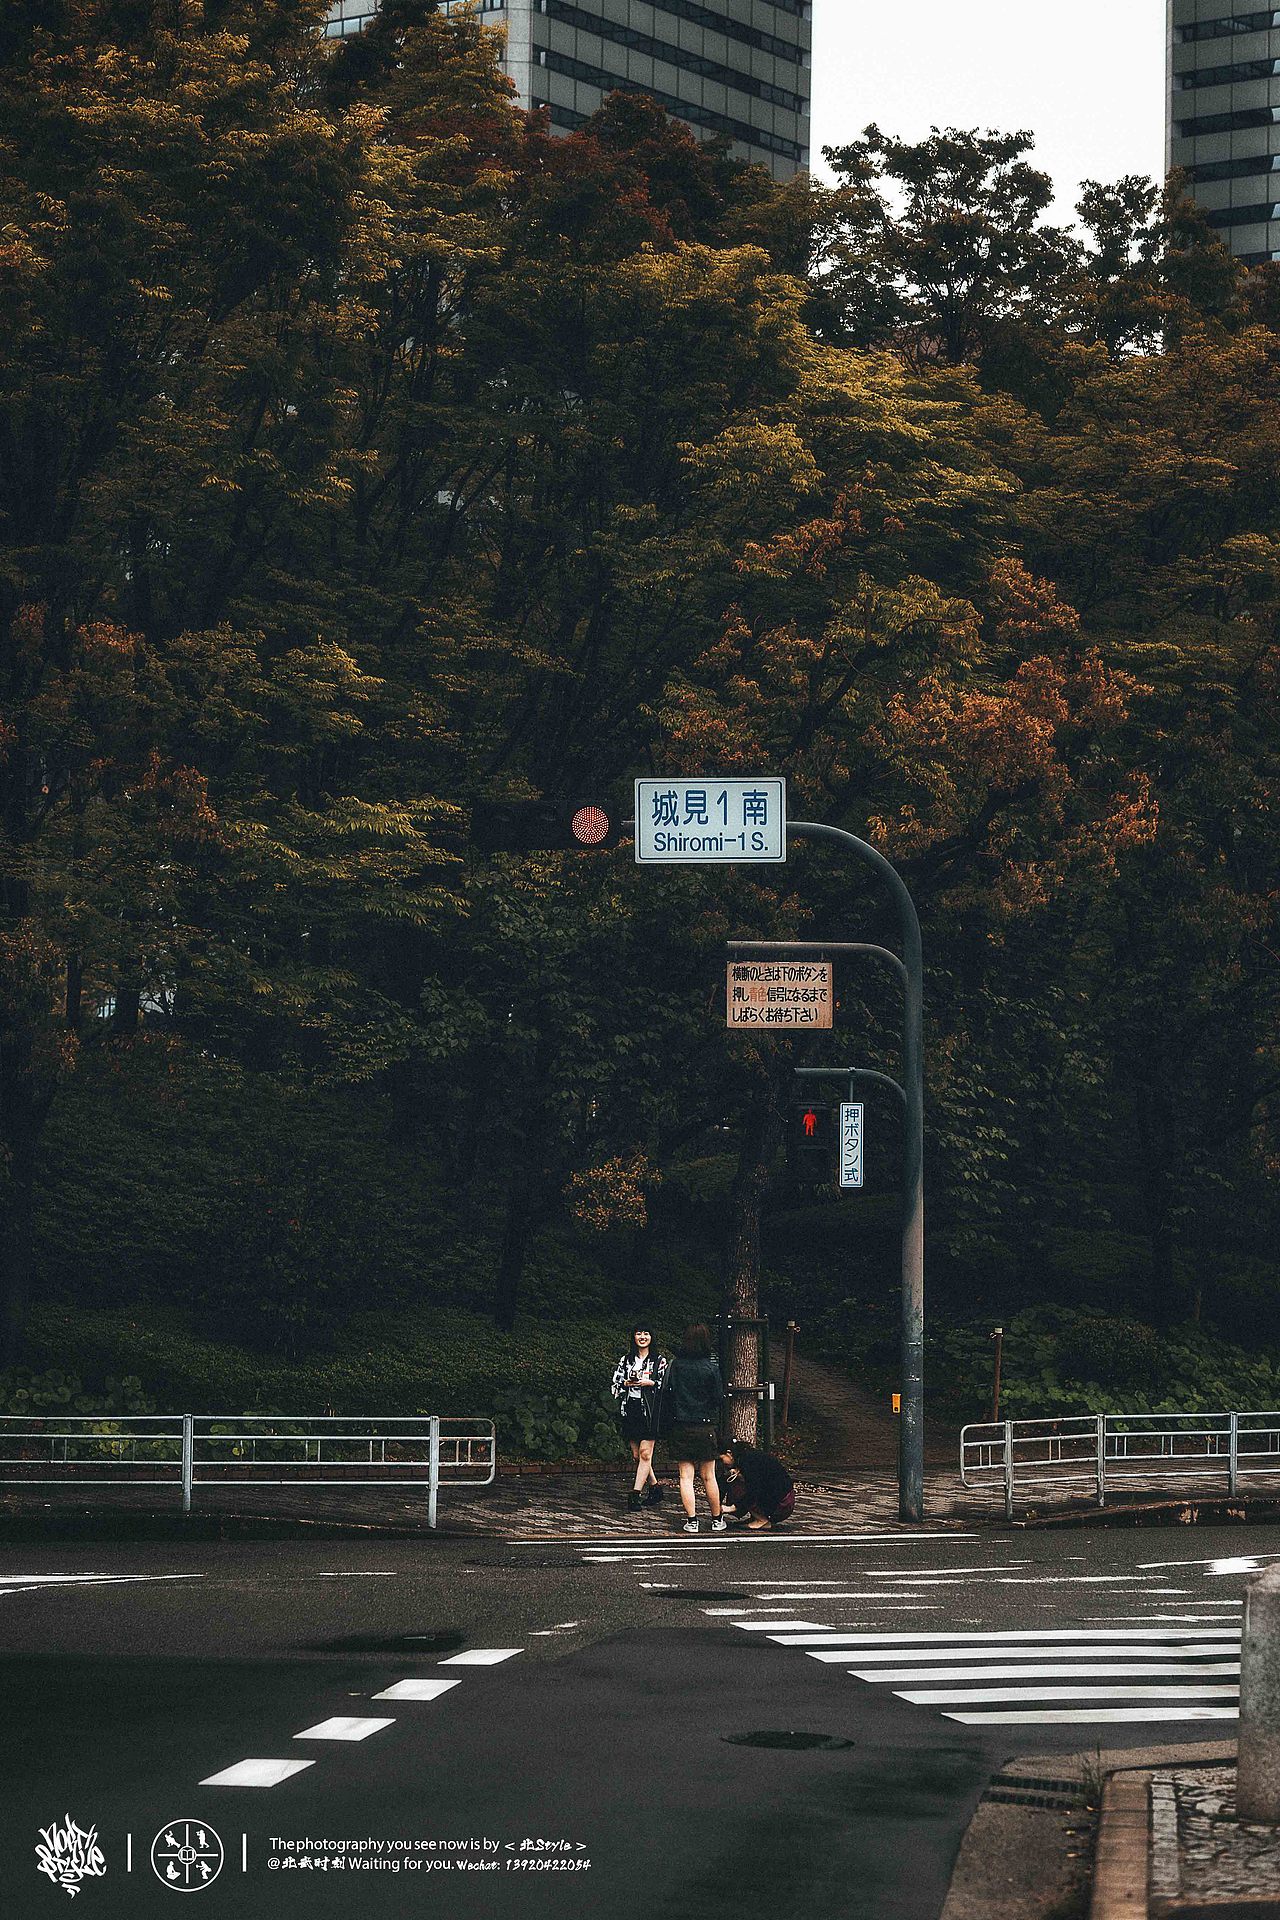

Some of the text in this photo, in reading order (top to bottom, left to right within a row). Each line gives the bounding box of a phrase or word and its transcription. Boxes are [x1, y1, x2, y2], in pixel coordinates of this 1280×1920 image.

[651, 788, 769, 827] 城見1南
[732, 966, 828, 982] 横断のときは下のボタンを
[732, 986, 828, 1003] 押し青色信号になるまで
[732, 1007, 818, 1023] しばらくお待ち下さい
[844, 1107, 860, 1182] 押ボタン式
